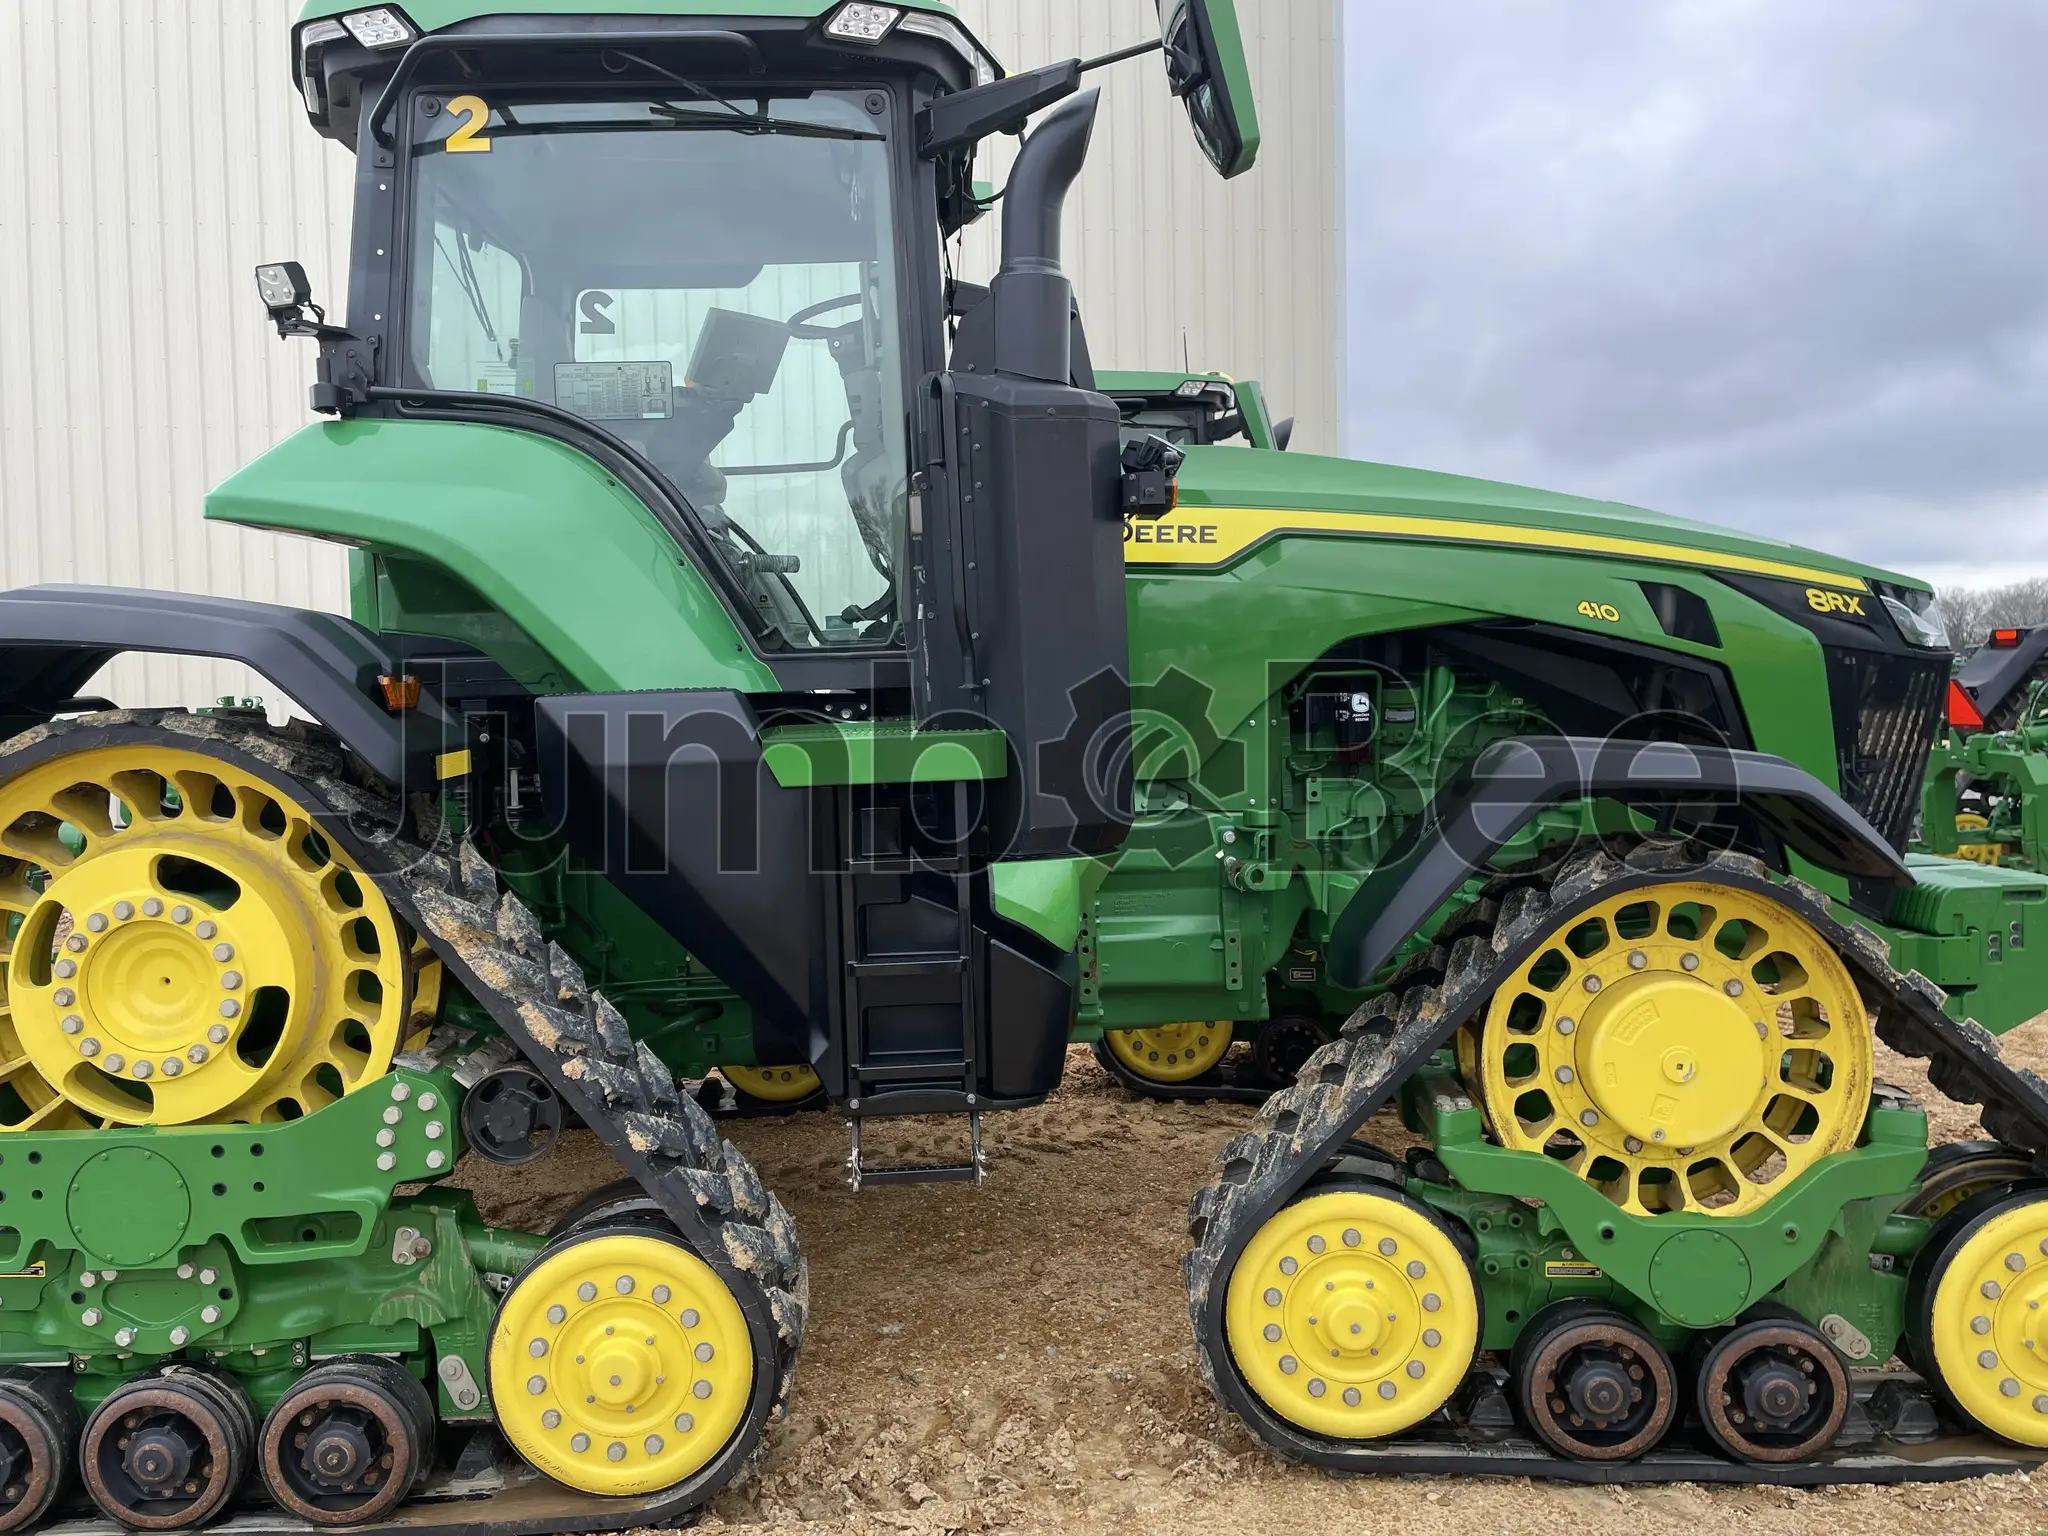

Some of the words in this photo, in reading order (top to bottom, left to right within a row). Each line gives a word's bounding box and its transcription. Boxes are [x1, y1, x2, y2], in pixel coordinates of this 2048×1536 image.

[445, 95, 491, 153] 2
[1577, 600, 1620, 622] 410
[1805, 588, 1866, 616] 8RX
